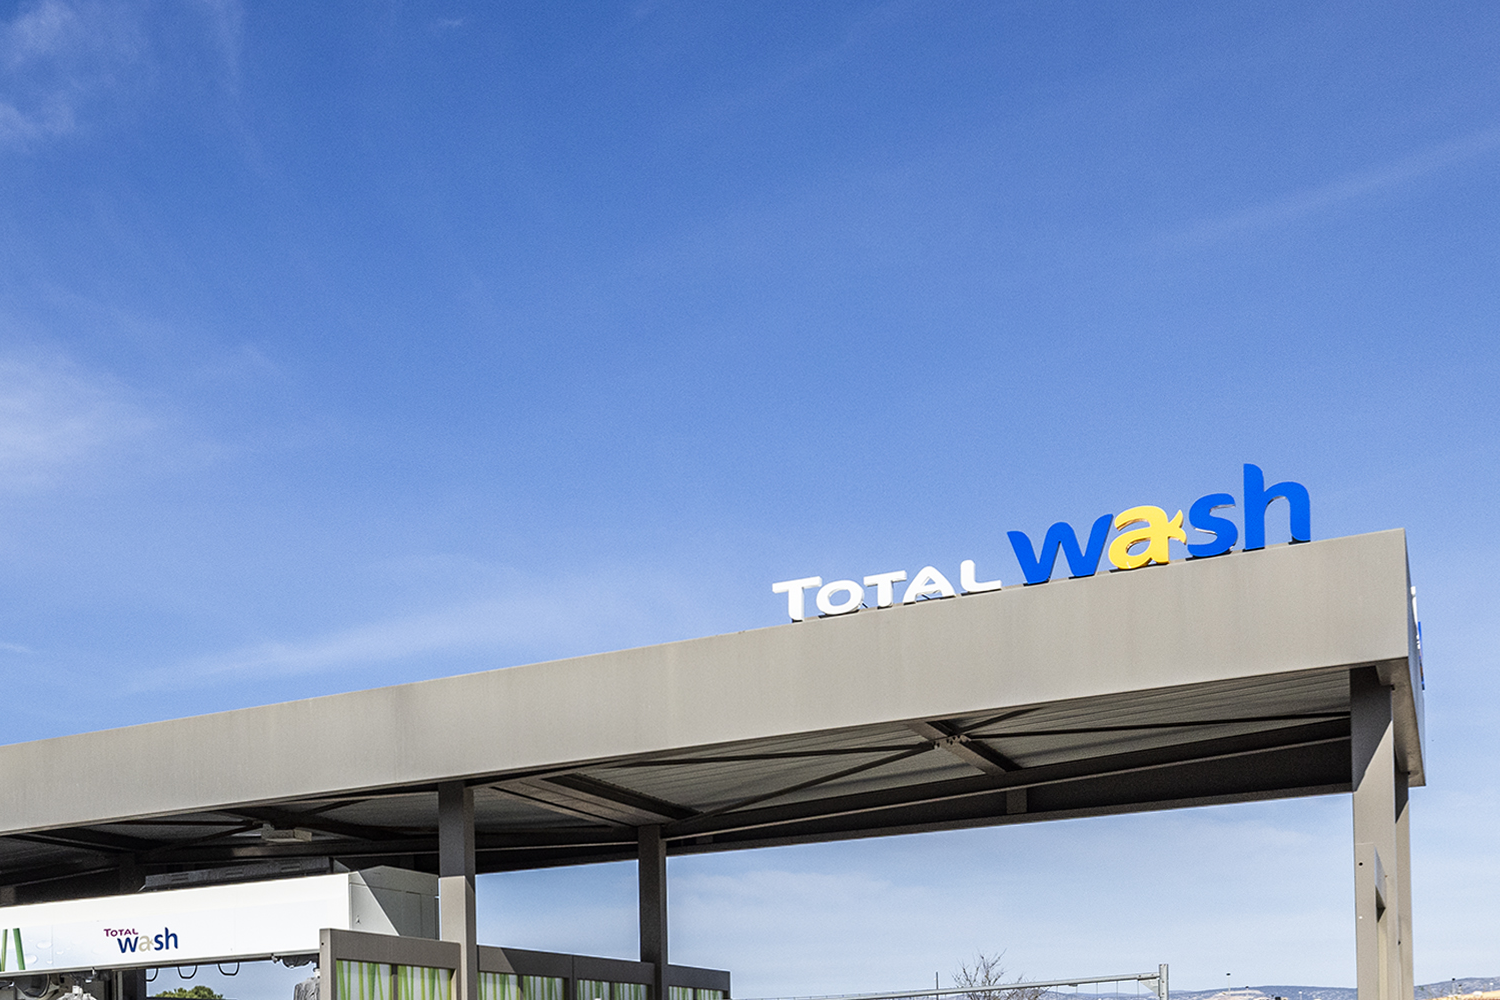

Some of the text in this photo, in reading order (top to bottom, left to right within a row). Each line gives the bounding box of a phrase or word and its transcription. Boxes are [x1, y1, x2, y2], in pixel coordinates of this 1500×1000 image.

[771, 463, 1310, 621] TOTAL wash
[104, 928, 139, 937] TOTAL
[117, 927, 178, 953] wash
